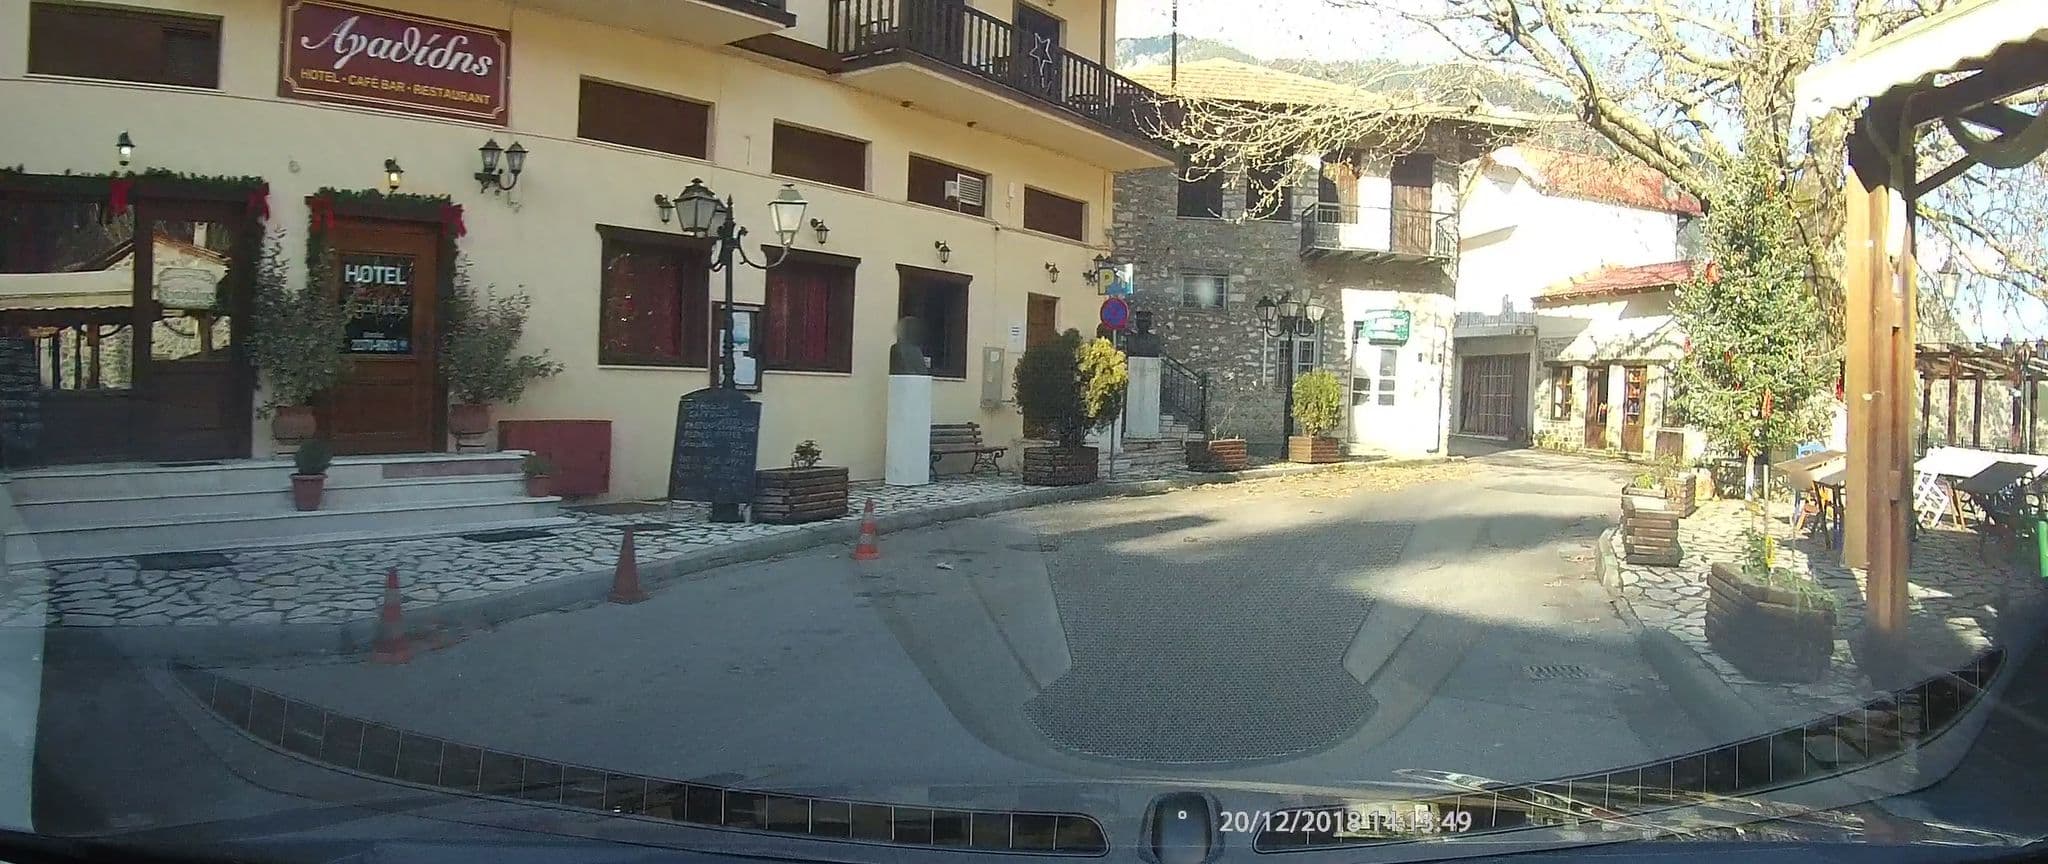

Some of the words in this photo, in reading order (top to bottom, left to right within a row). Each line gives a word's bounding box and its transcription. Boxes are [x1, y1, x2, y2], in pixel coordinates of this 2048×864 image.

[300, 68, 340, 84] HOTEL
[380, 79, 406, 93] BAR
[412, 83, 491, 104] RESTAURANT
[344, 264, 407, 285] HOTEL
